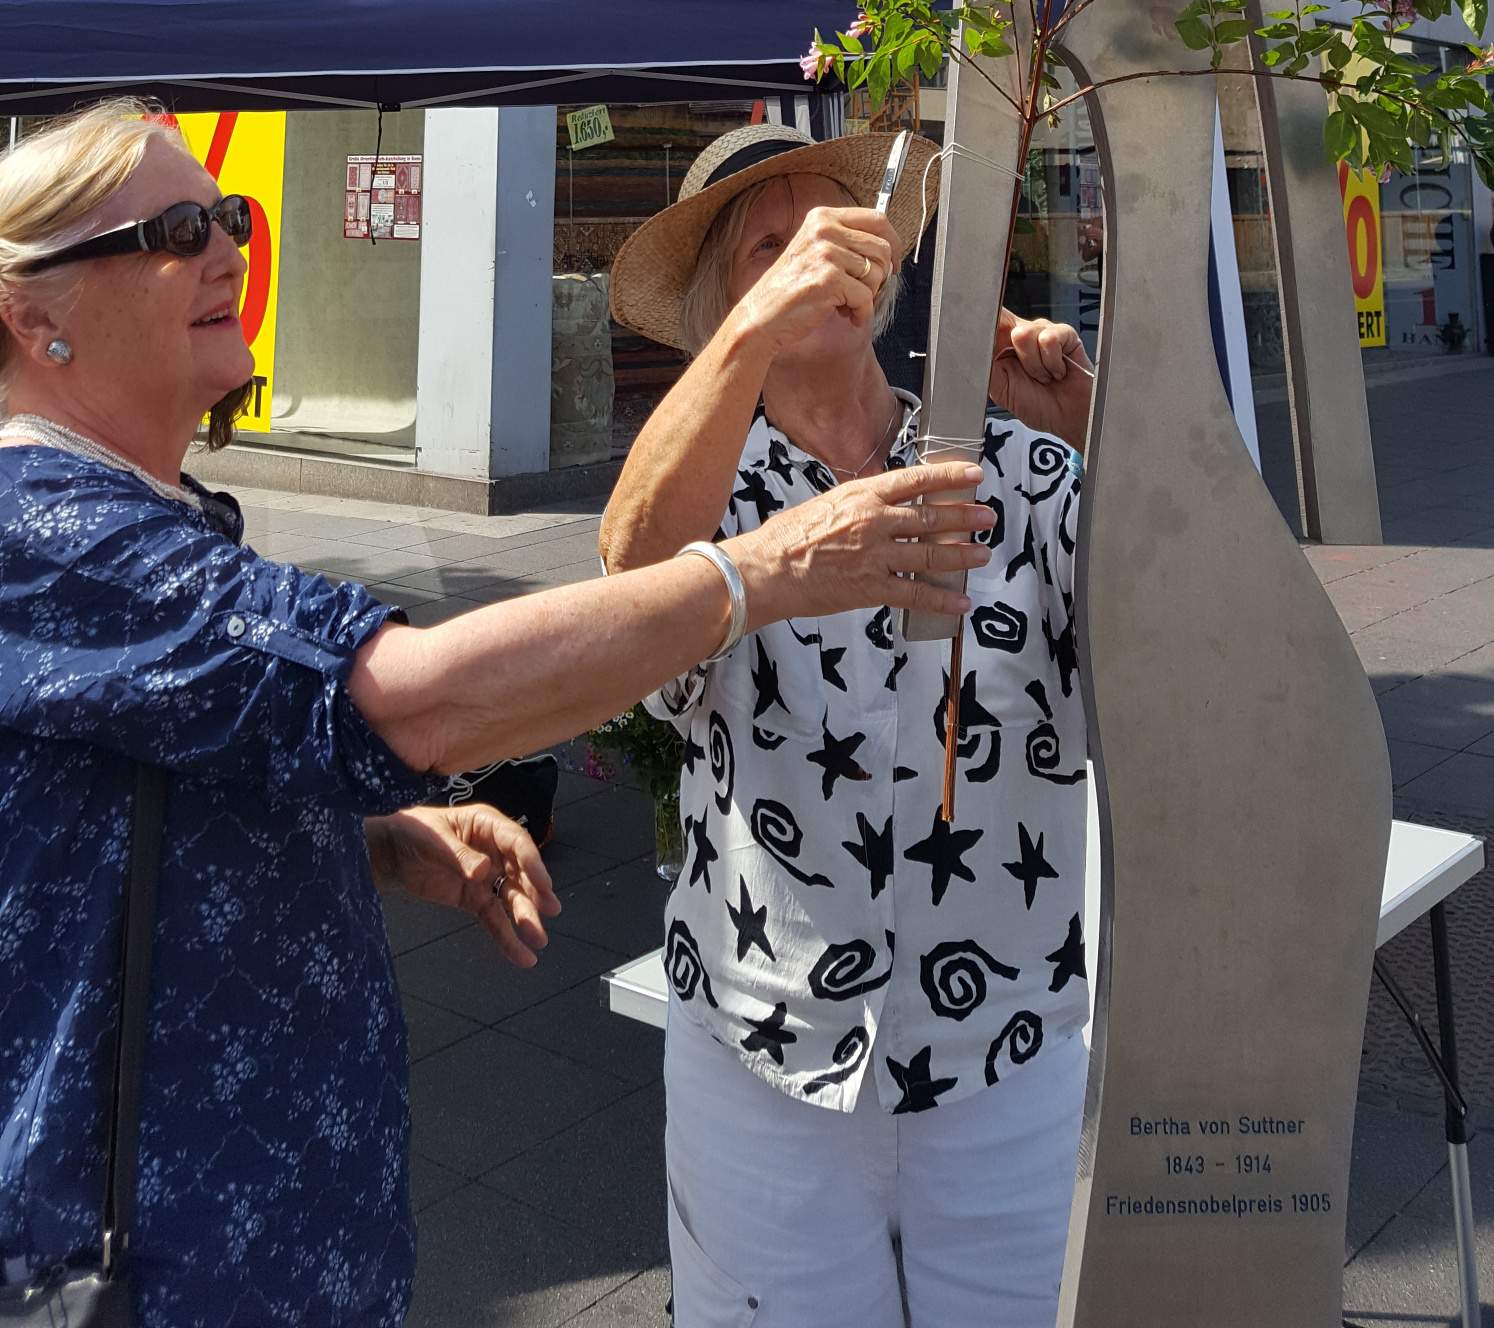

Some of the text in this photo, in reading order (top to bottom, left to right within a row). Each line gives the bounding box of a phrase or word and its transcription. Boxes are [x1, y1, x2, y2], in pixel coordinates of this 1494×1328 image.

[1357, 311, 1382, 339] ERT
[1130, 1117, 1305, 1136] Bertha von Suttner
[1165, 1155, 1205, 1174] 1843
[1235, 1154, 1272, 1173] 1914
[1106, 1193, 1331, 1217] Friedensnobelpreis 1905
